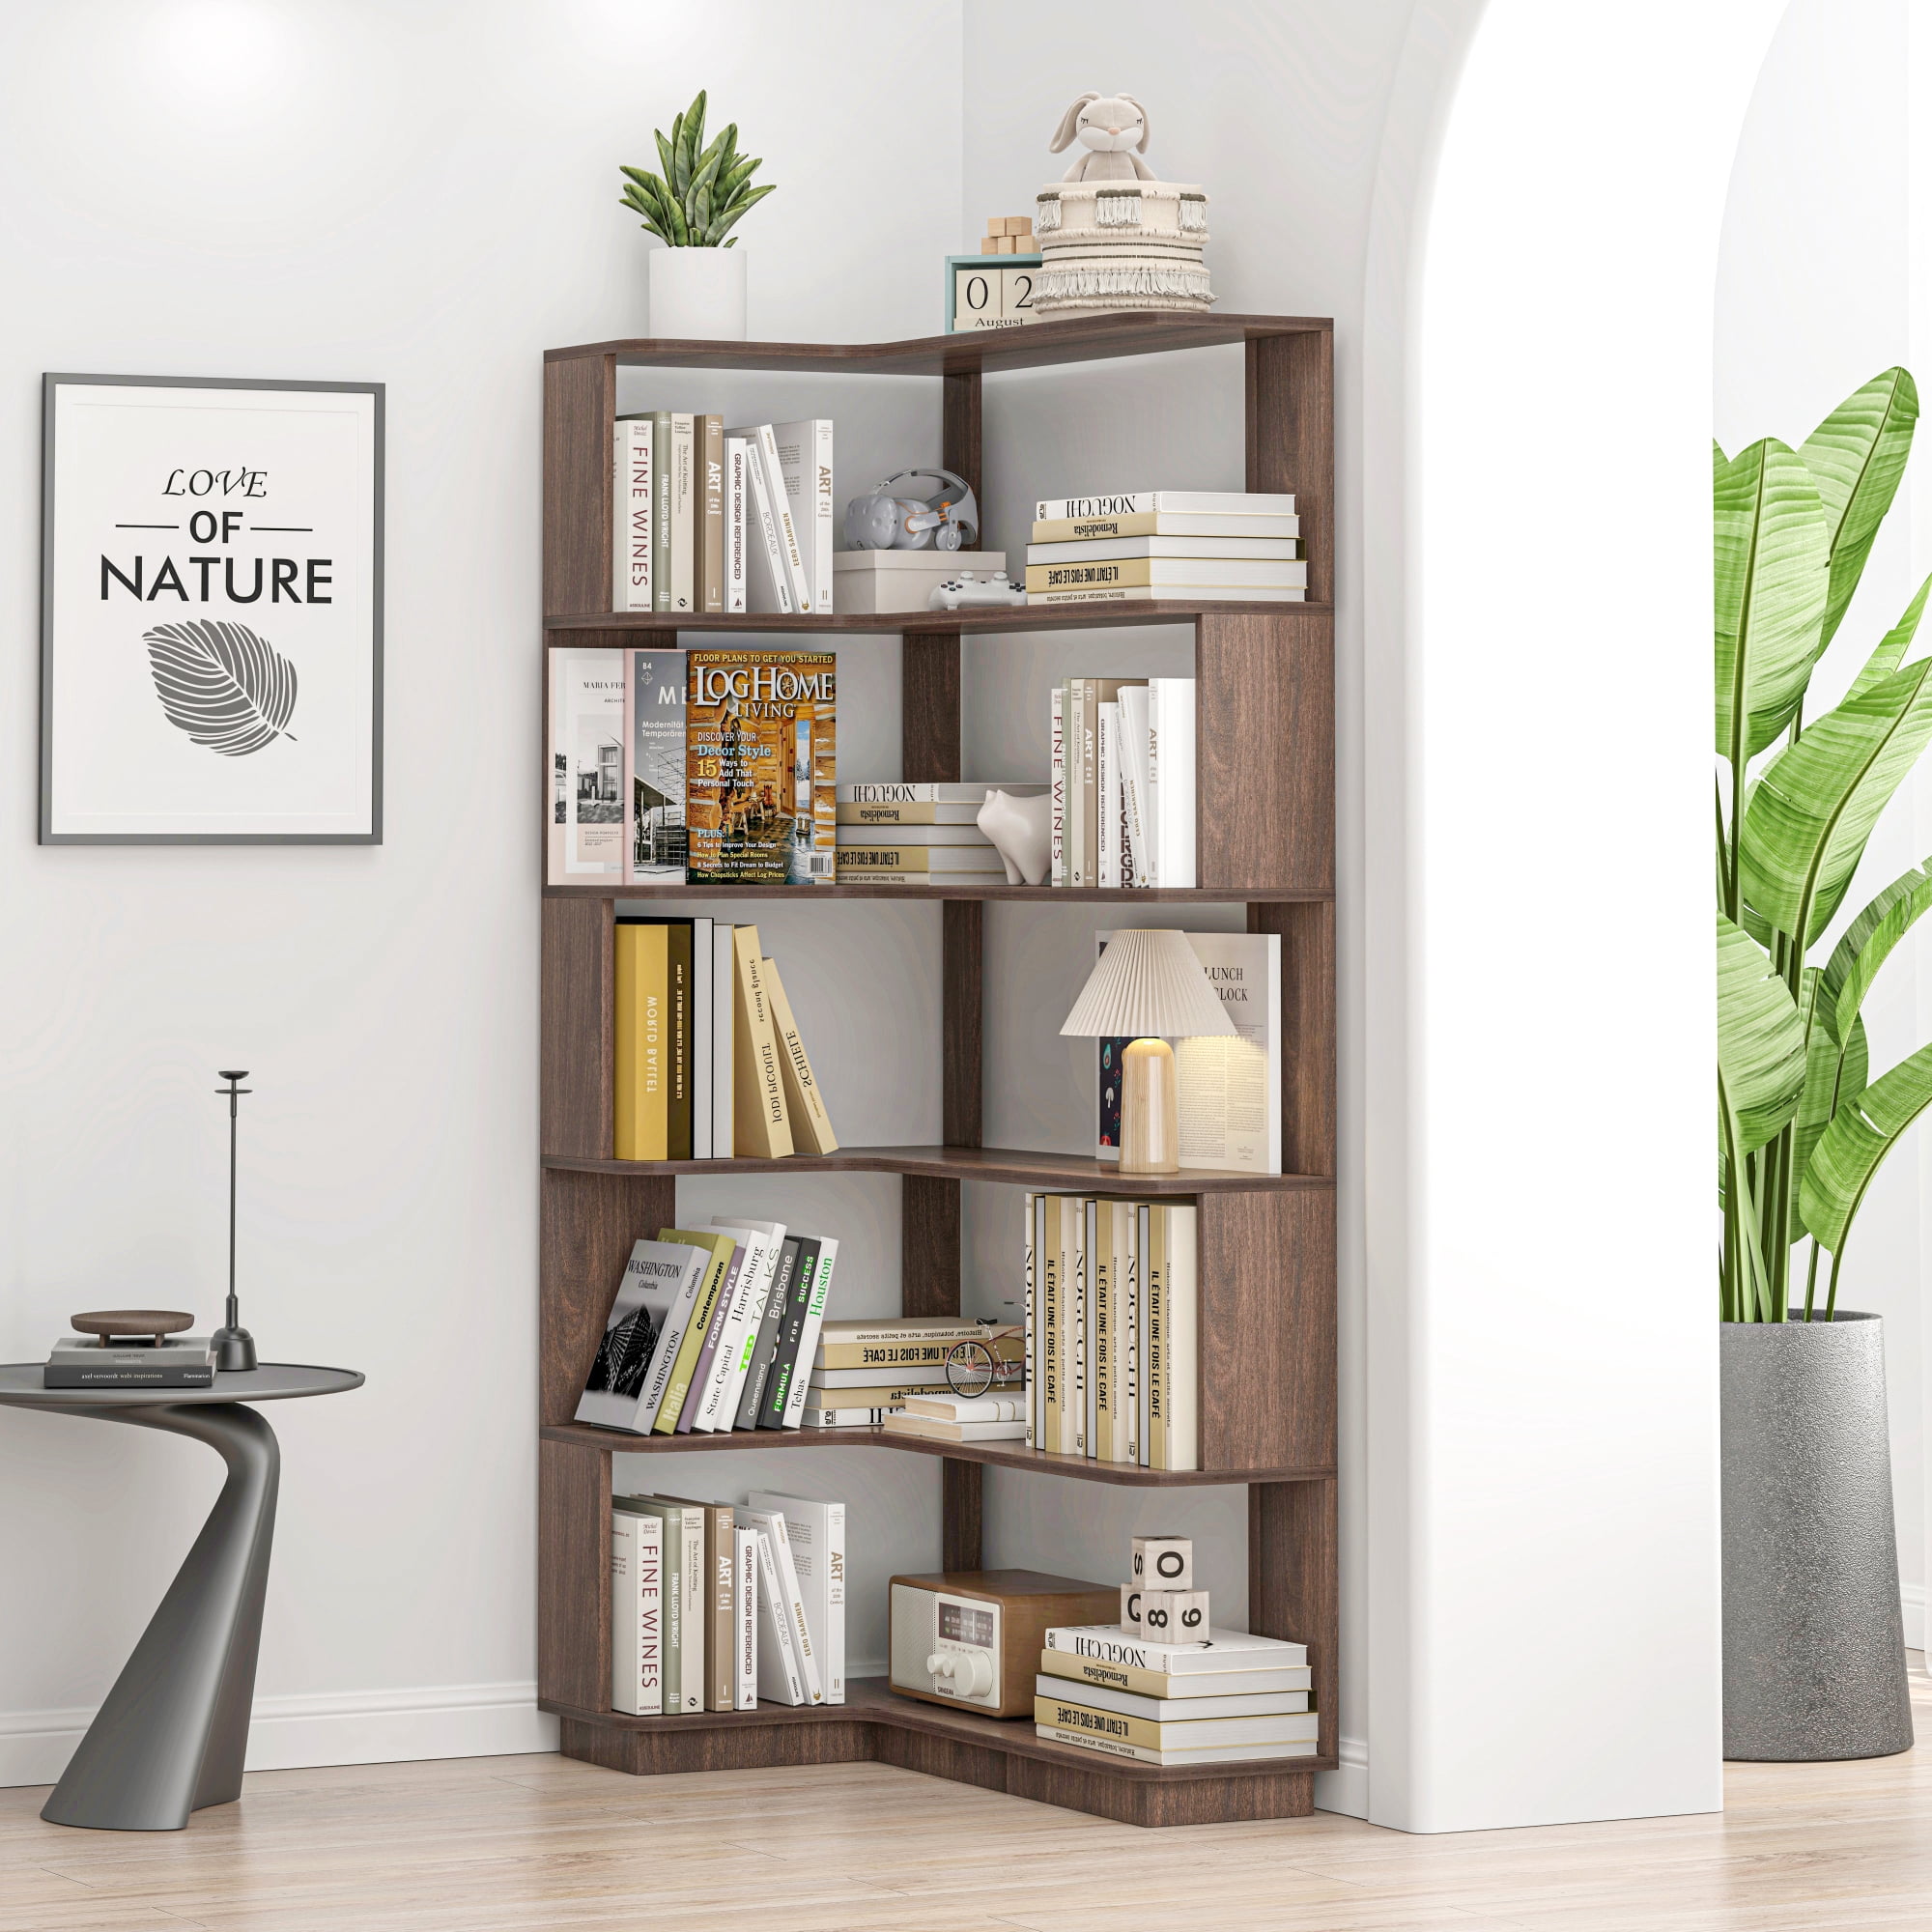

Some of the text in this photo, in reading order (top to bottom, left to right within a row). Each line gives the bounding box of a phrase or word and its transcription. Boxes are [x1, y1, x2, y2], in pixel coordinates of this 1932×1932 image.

[1015, 275, 1034, 309] 2
[975, 317, 1025, 329] August
[161, 467, 268, 497] LOVE
[633, 446, 648, 498] FINE
[708, 461, 722, 493] ART
[818, 466, 831, 496] ART
[661, 473, 669, 549] FRANK LLOYD WRIGHT
[1066, 495, 1136, 518] NOGUCHI
[190, 510, 243, 544] OF
[1074, 523, 1119, 537] Remodelista
[633, 509, 648, 586] WINES
[100, 554, 332, 604] NATURE
[694, 653, 834, 664] FLOOR PLANS TO GET YOU STARTED
[582, 681, 610, 690] MARIA
[735, 702, 795, 718] LIVING
[697, 731, 756, 742] DISCOVER YOUR
[697, 745, 772, 759] Decor Style
[1085, 728, 1094, 761] ART
[1149, 728, 1157, 760] ART
[696, 759, 718, 778] 15
[719, 758, 738, 768] Ways
[697, 779, 754, 787] Personal Touch
[719, 768, 753, 777] Add That
[854, 784, 917, 803] NOGUCHI
[1053, 716, 1063, 860] FINE WINES
[628, 1259, 683, 1279] WASHINGTON
[809, 1257, 833, 1317] Houston
[707, 1265, 739, 1350] FORM STYLE
[739, 1248, 781, 1373] TED TALKS
[646, 1266, 701, 1411] WASHINGTON Columbia
[663, 1261, 724, 1423] Italia Contemporan
[706, 1246, 765, 1416] State Capital Harrisburg
[748, 1254, 793, 1416] Queensland Brisbane
[774, 1255, 815, 1412] FORMULA FOR SUCCESS
[1047, 1260, 1057, 1404] IL ÉTAIT UNE FOIS LE CAFÉ
[1098, 1265, 1108, 1411] IL ÉTAIT UNE FOIS LE CAFÉ
[1151, 1271, 1161, 1418] IL ÉTAIT UNE FOIS LE CAFÉ
[641, 1546, 658, 1598] FINE
[719, 1555, 732, 1588] ART
[831, 1551, 843, 1581] ART
[641, 1608, 658, 1689] WINES
[1075, 1636, 1147, 1668] NOGUCHI
[1083, 1665, 1128, 1687] Remodelista
